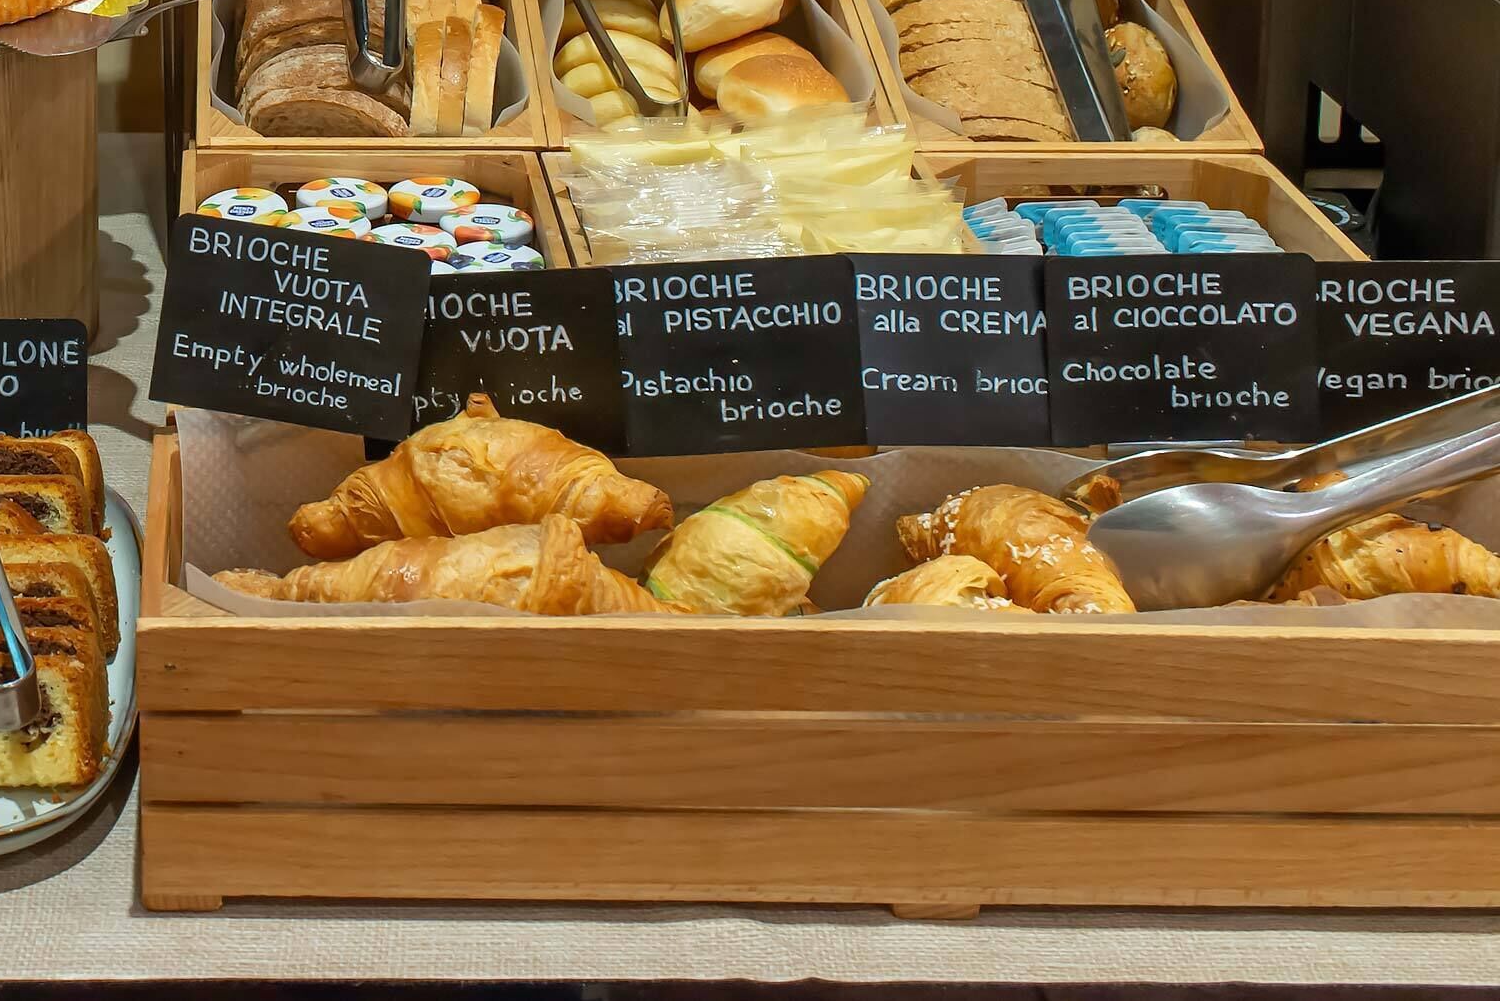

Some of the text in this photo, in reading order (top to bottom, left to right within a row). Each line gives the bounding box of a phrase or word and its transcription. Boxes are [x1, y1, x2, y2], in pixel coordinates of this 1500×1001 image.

[188, 226, 330, 273] BRIOCHE
[274, 269, 369, 309] VUOTA
[855, 274, 1002, 302] BRIOCHE
[1068, 272, 1223, 300] BRIOCHE
[1315, 278, 1456, 305] RIOCHE
[219, 290, 383, 344] INTEGRALE
[423, 292, 533, 320] IOCHE
[664, 301, 842, 333] PISTACCHIO
[1073, 302, 1298, 332] al CIOCCOLATO
[873, 309, 1047, 336] alla CREMA
[1344, 310, 1496, 337] VEGANA
[460, 324, 574, 354] VUOTA
[172, 333, 402, 397] Empty wholemeal
[1062, 354, 1219, 382] Chocolate
[255, 375, 349, 410] brioche
[861, 367, 1049, 395] Cream brioc
[1171, 381, 1291, 408] brioche
[720, 393, 842, 423] brioche
